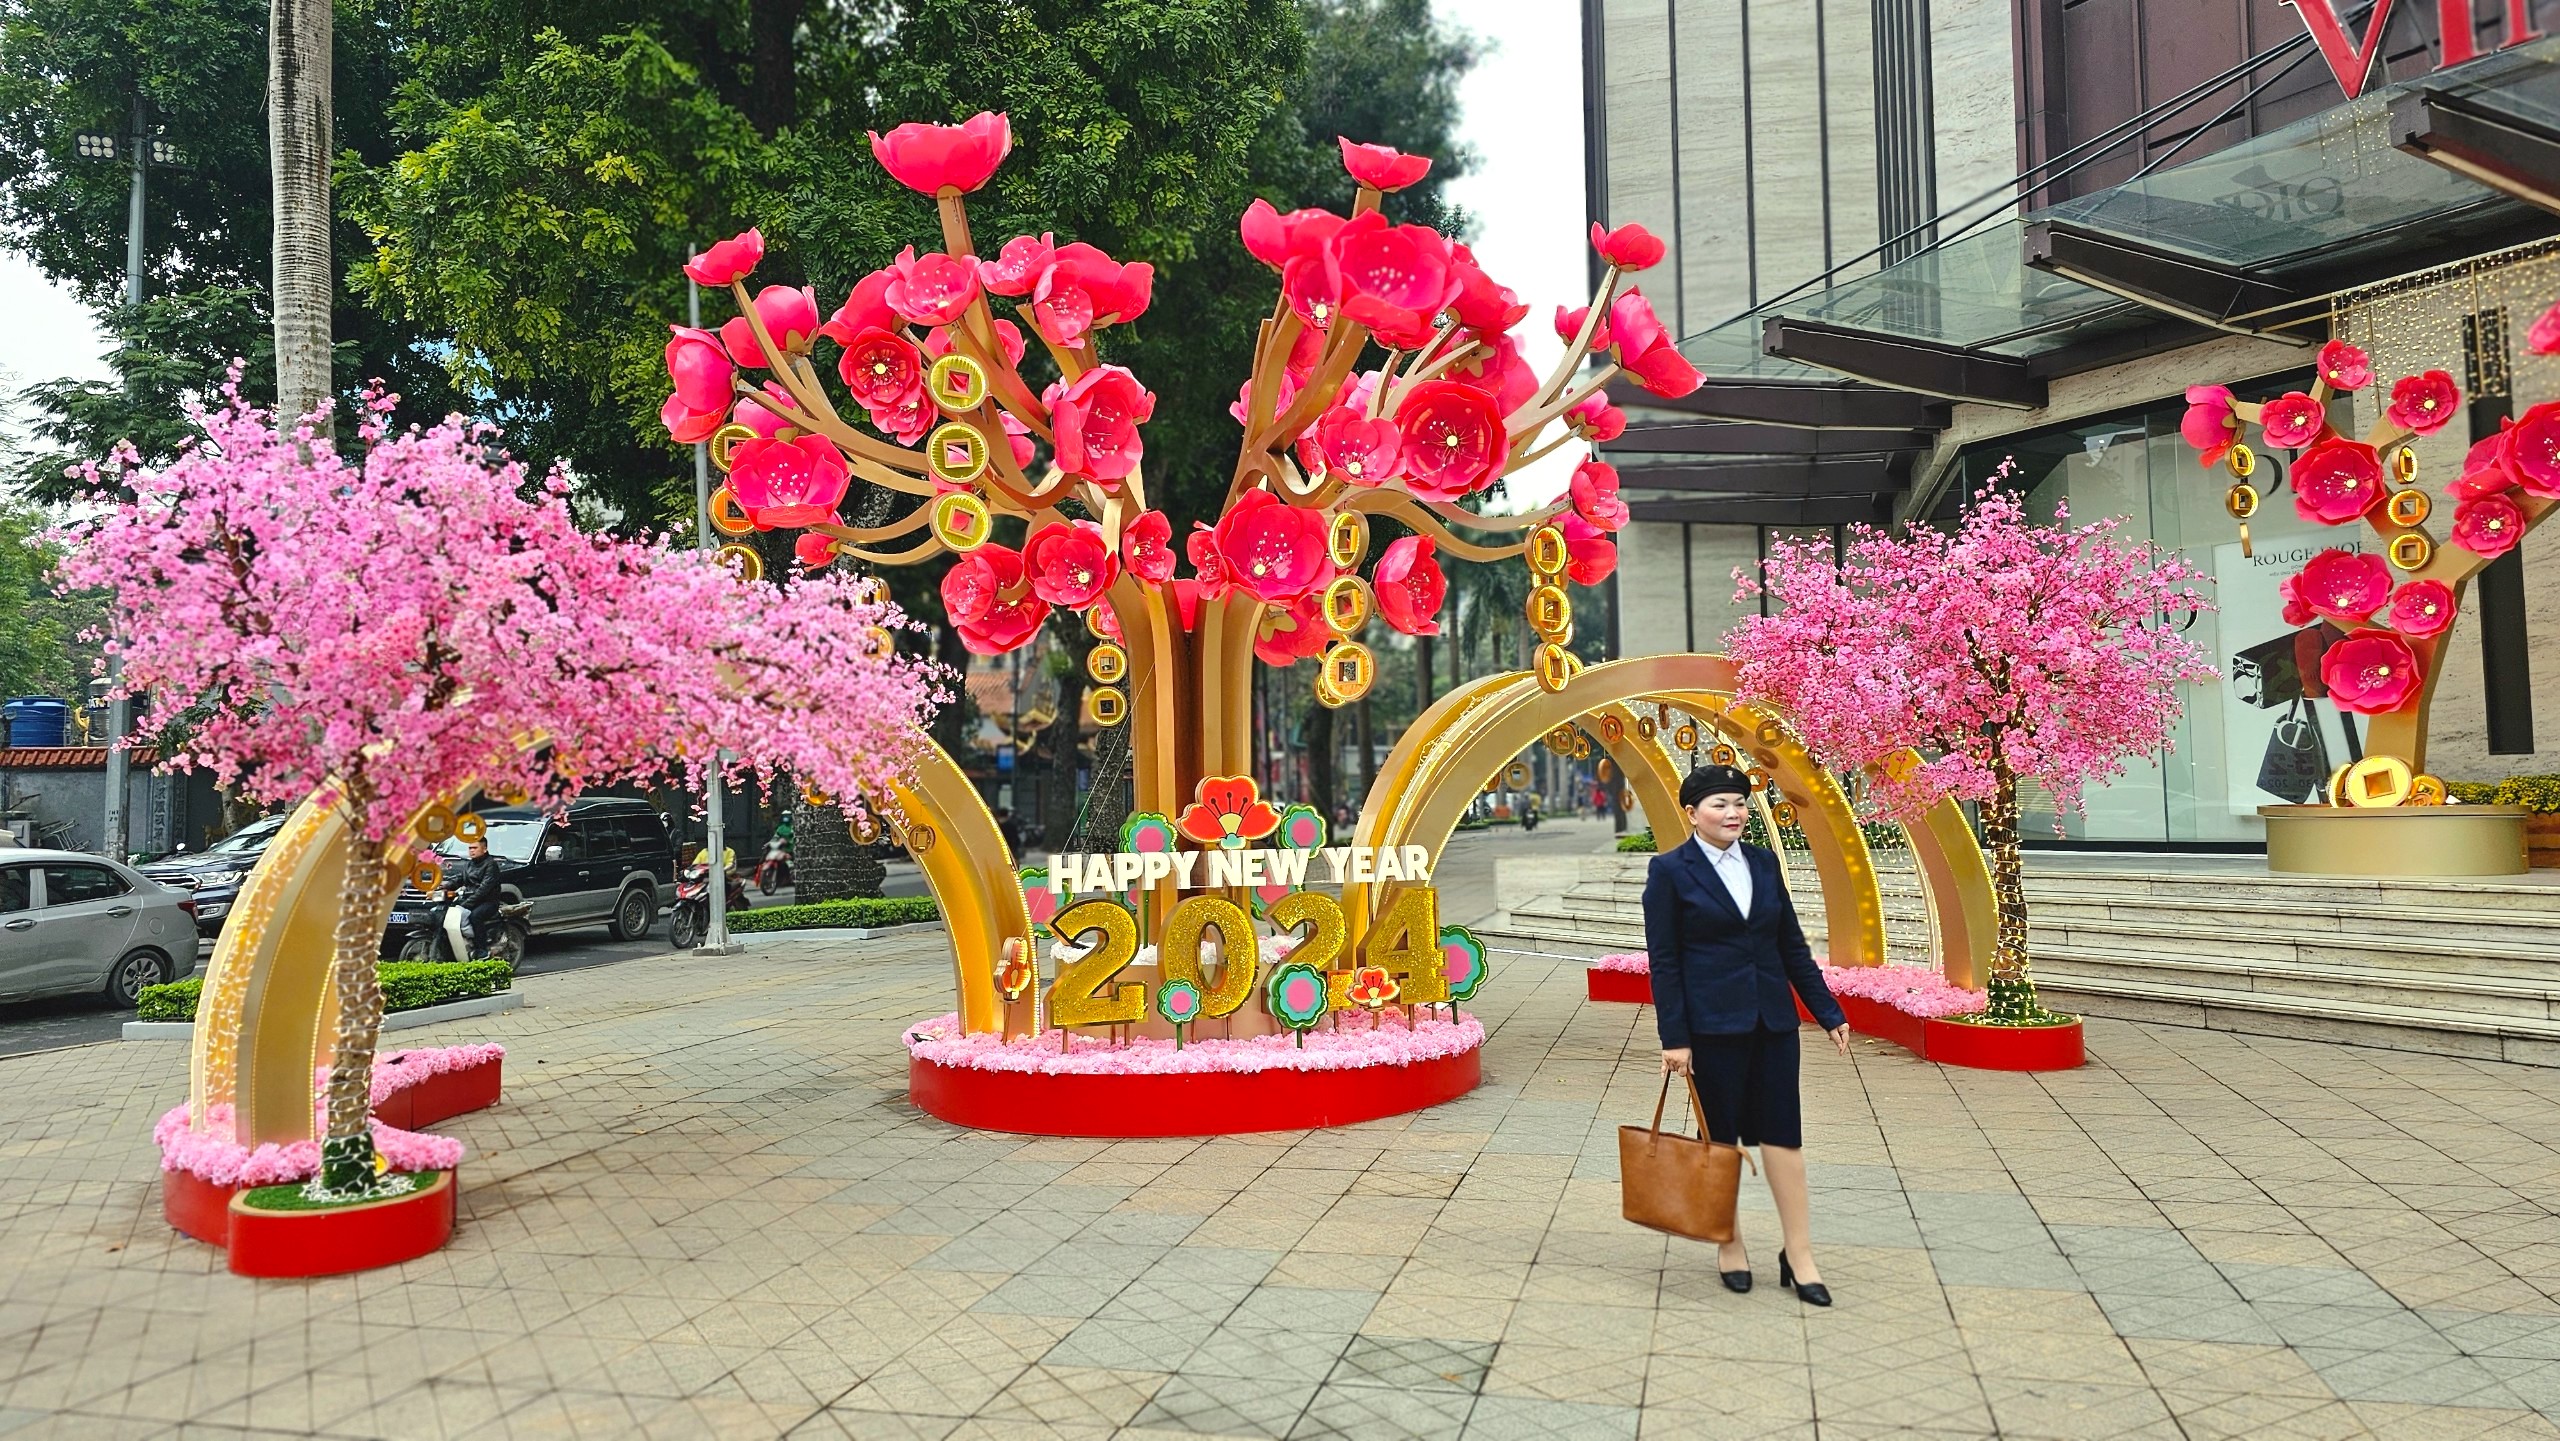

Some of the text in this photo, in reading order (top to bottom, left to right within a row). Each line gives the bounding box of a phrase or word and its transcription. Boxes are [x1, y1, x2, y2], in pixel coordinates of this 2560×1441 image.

[2253, 548, 2314, 567] ROUGE
[1048, 844, 1431, 895] HAPPY NEW YEAR
[1044, 886, 1451, 1030] 2024
